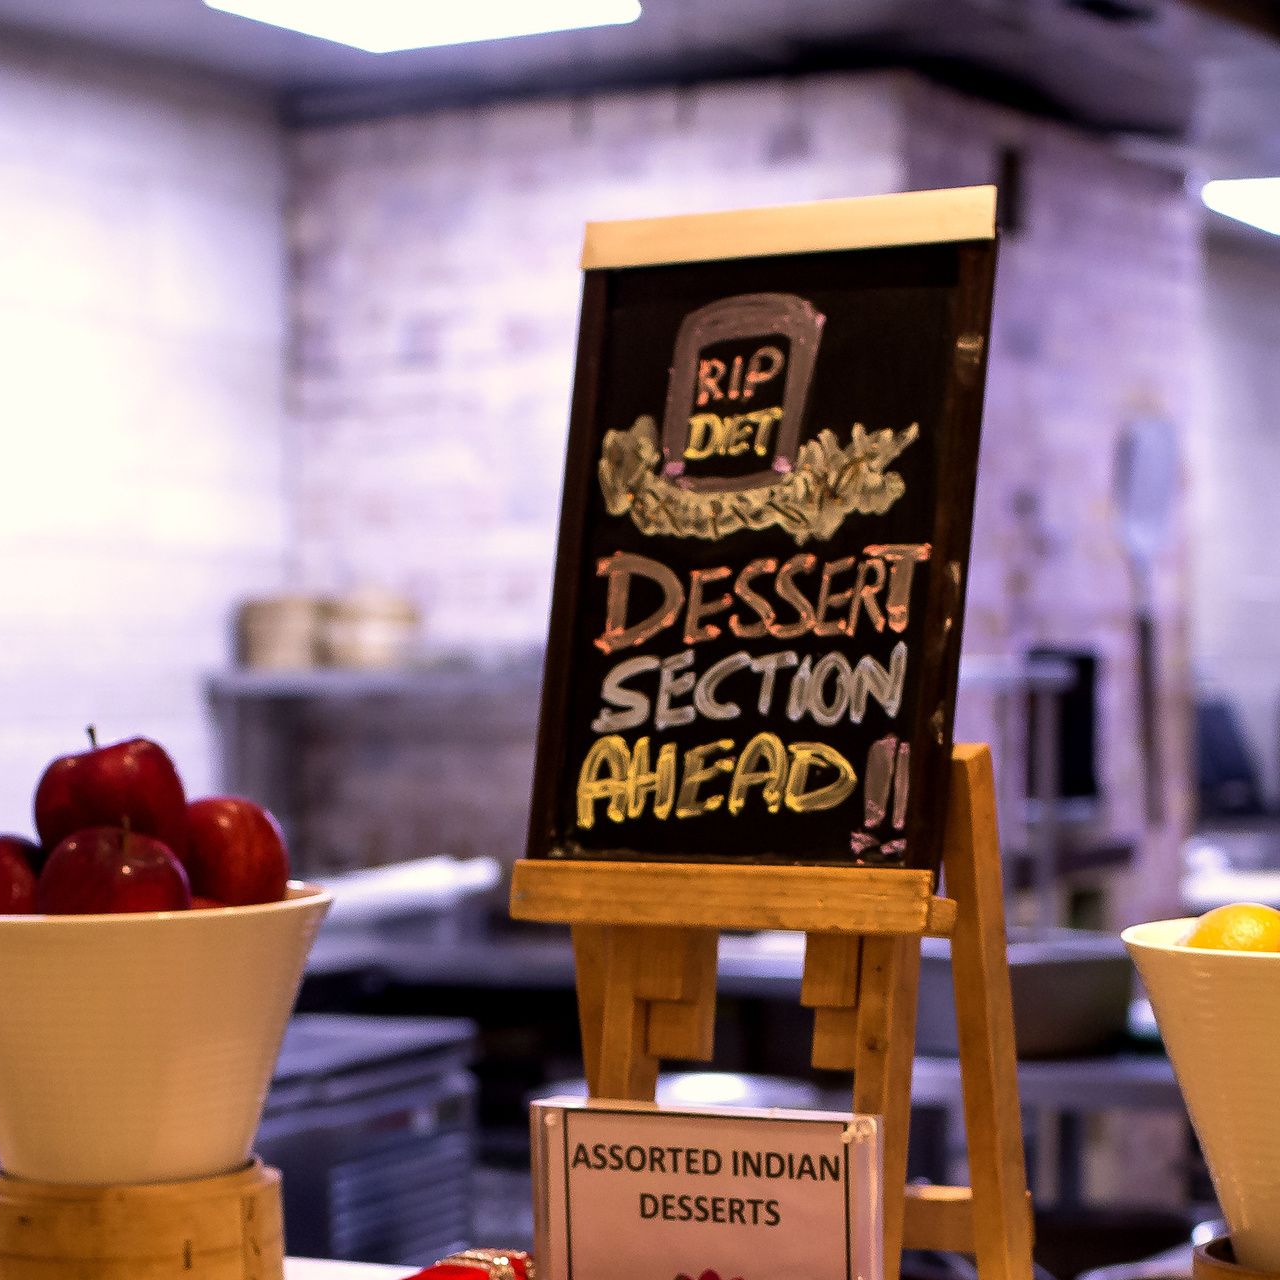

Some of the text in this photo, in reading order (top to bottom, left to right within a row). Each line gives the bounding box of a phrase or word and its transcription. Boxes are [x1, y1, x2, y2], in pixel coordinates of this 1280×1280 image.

[697, 345, 784, 406] RIP
[684, 406, 782, 460] DIET
[593, 543, 933, 654] DESSERT
[590, 641, 908, 734] SECTION
[571, 1142, 841, 1182] ASSORTED INDIAN
[639, 1192, 781, 1227] DESSERTS
